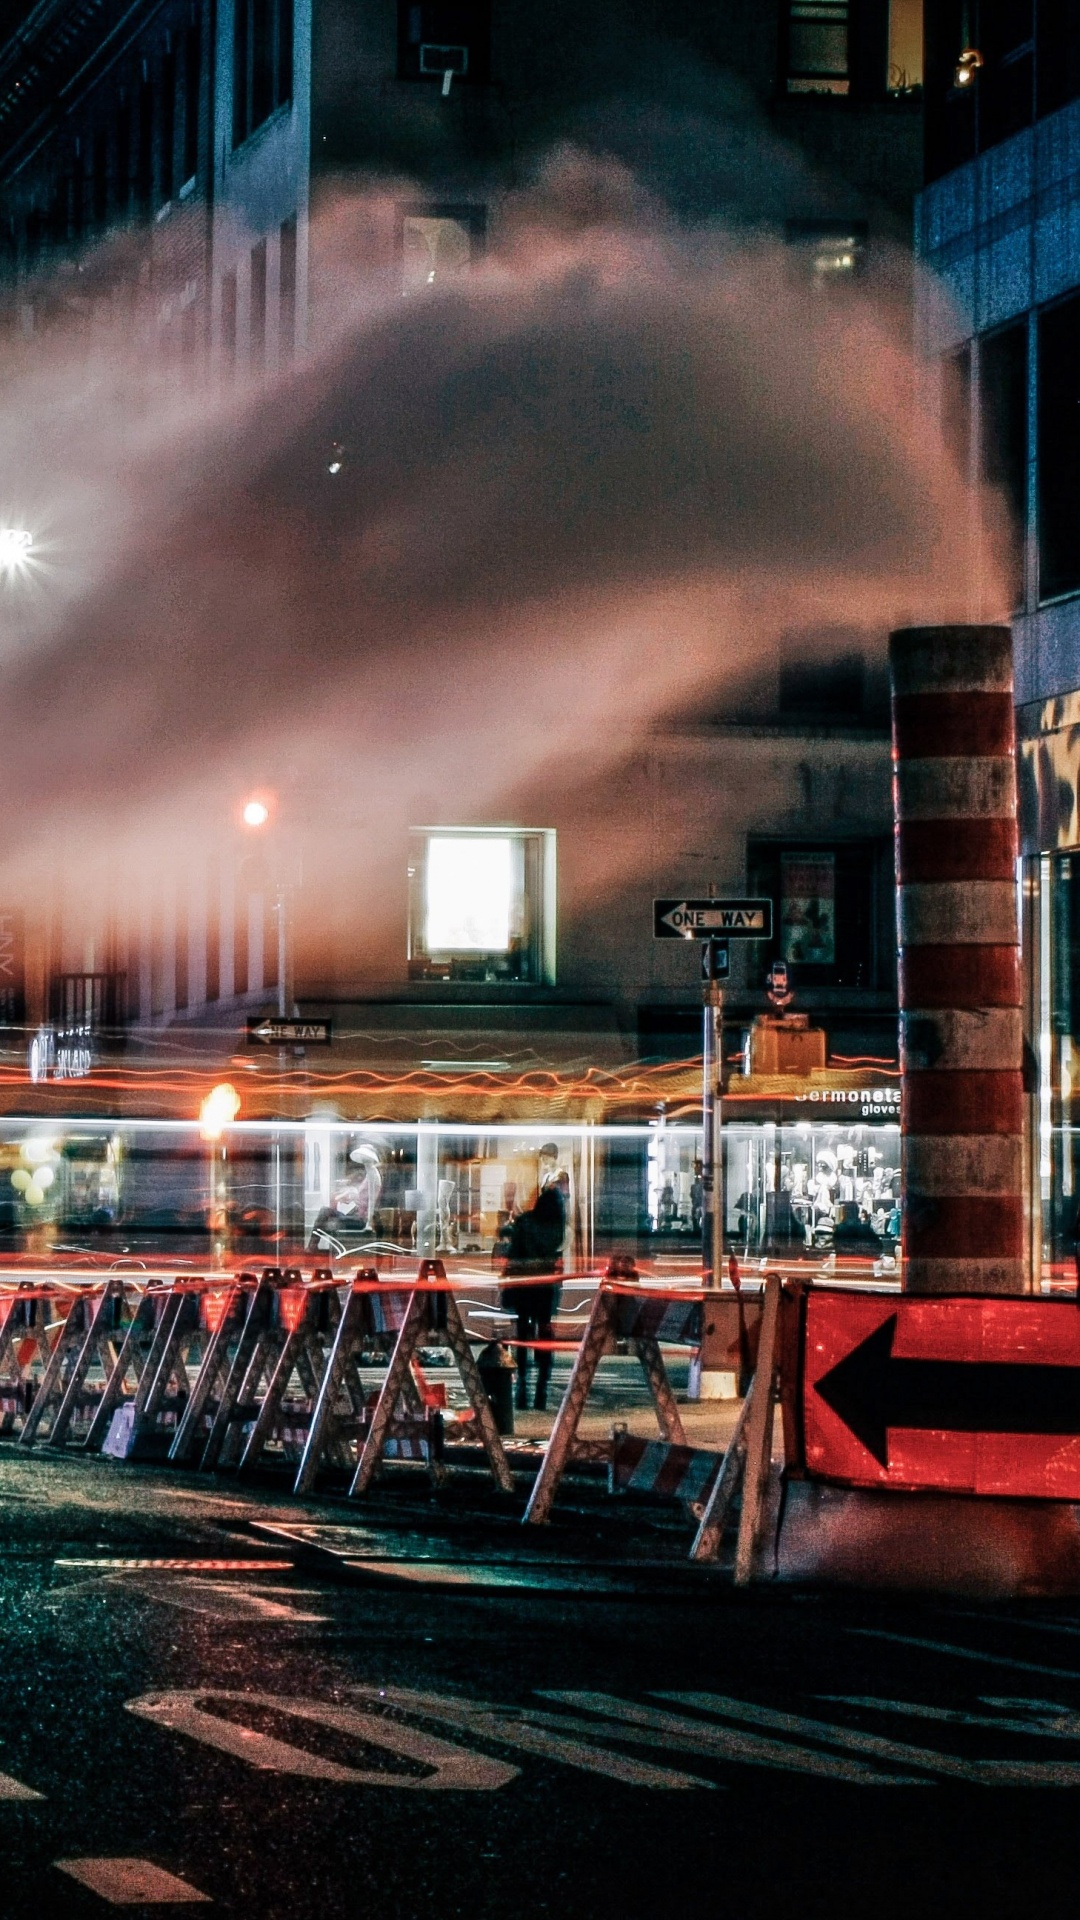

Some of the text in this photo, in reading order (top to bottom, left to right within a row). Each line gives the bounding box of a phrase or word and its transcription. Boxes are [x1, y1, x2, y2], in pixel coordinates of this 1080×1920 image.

[672, 912, 756, 926] ONE WAY
[262, 1026, 320, 1038] NE WAY
[862, 1104, 901, 1116] gloves
